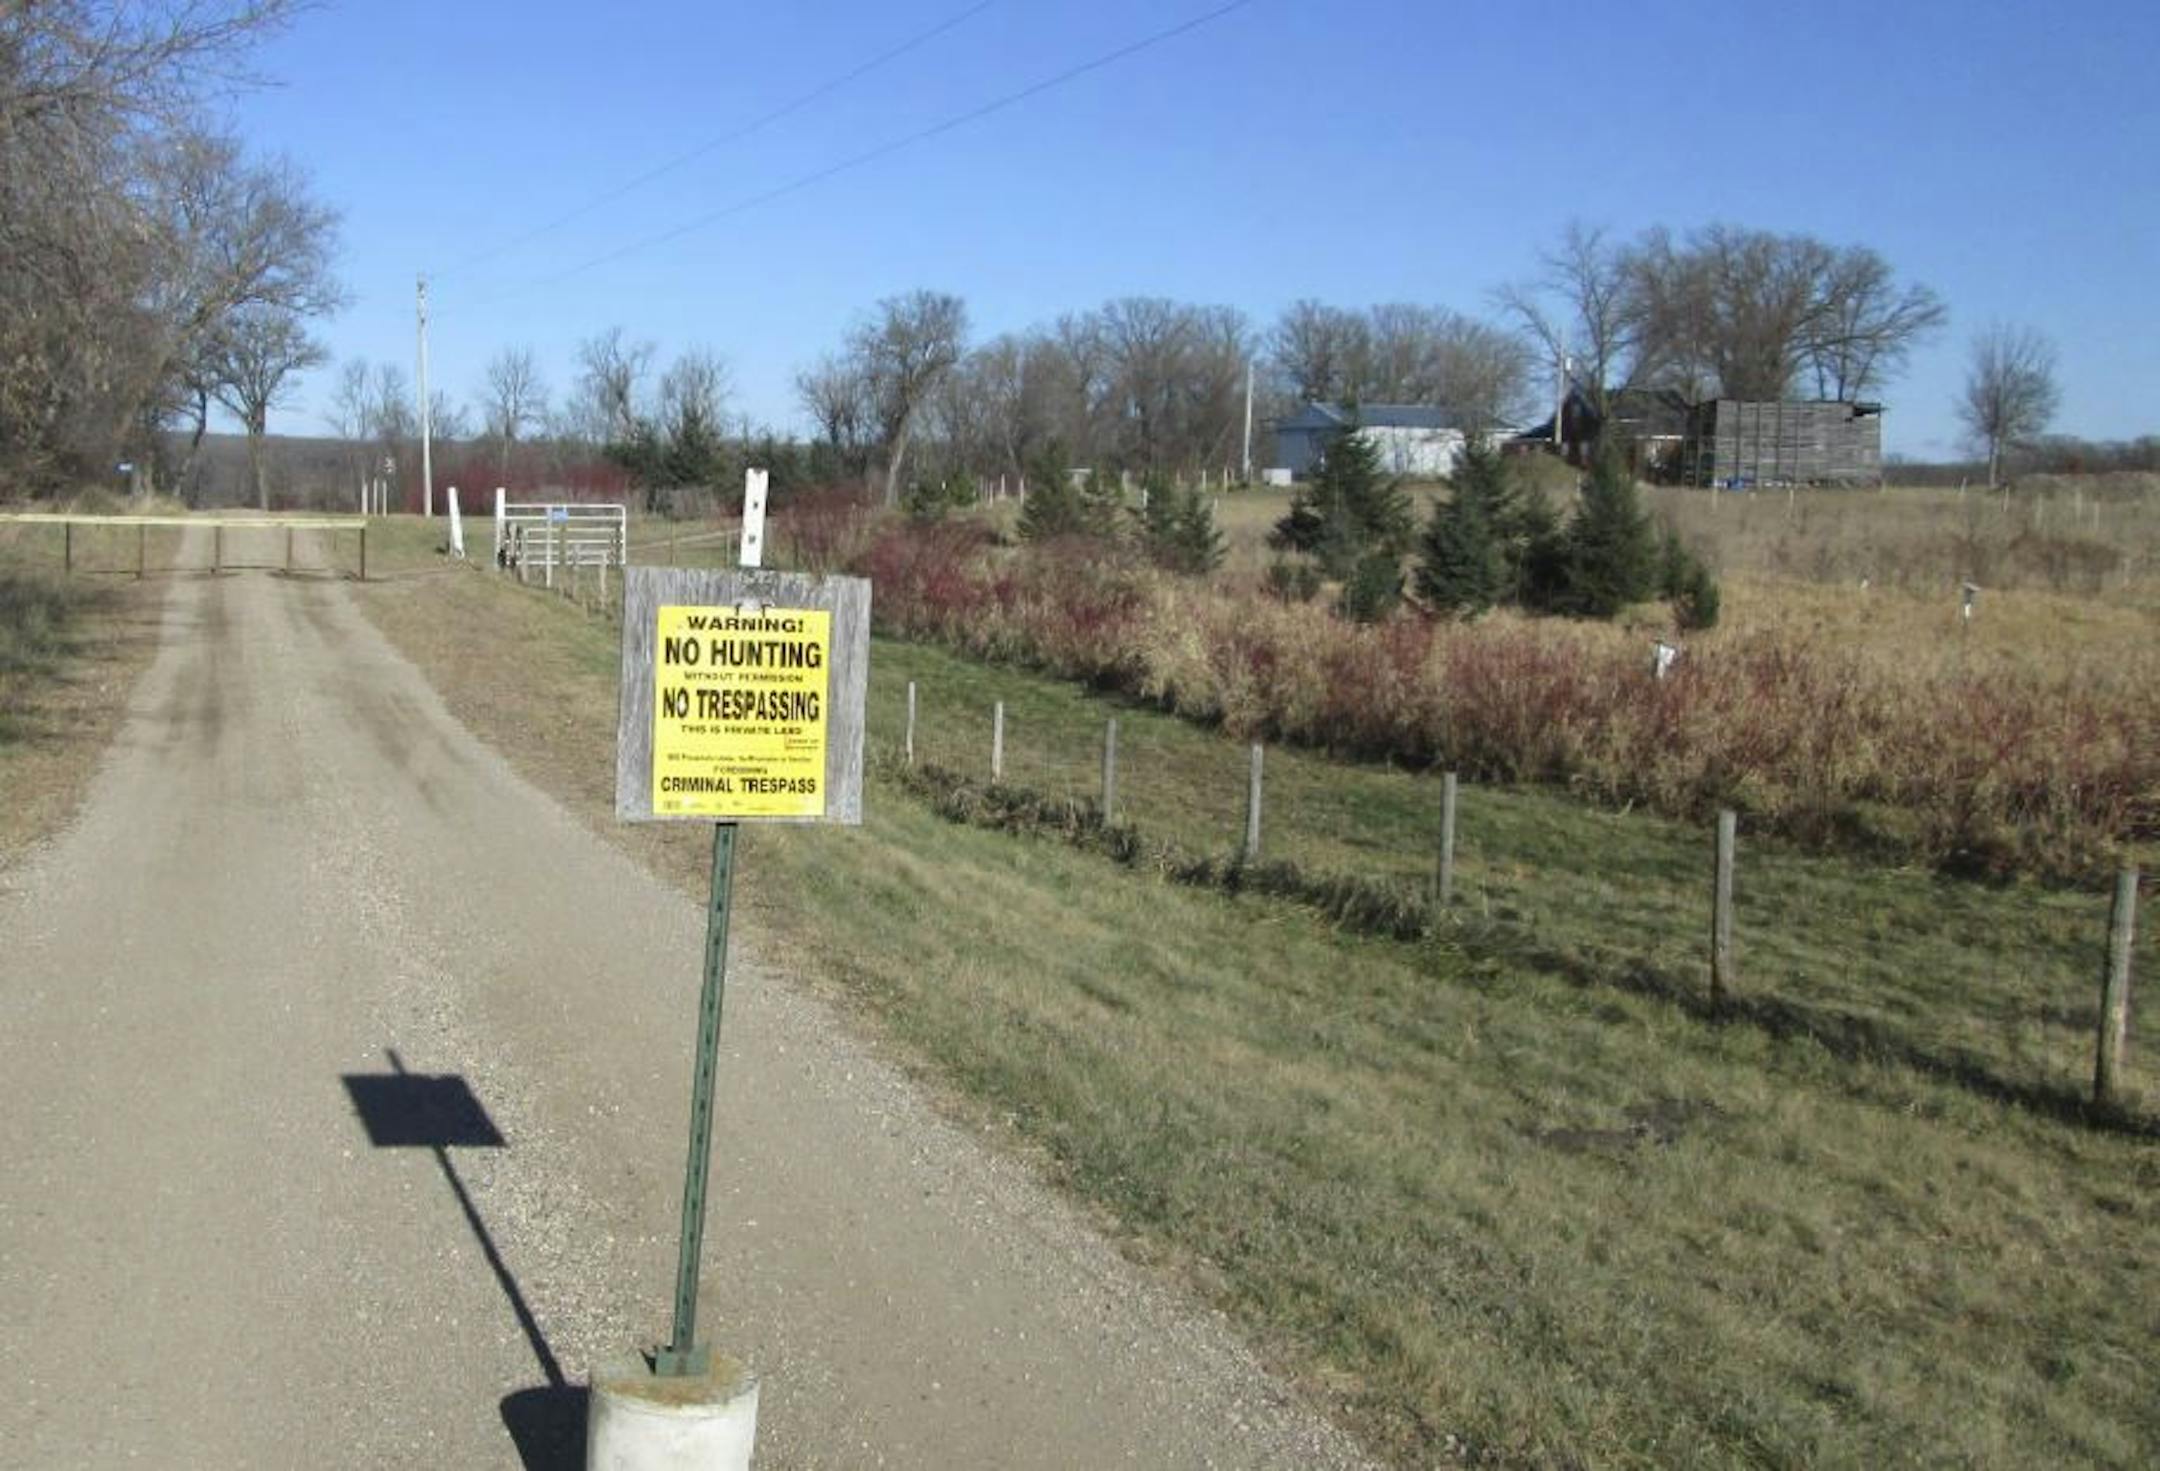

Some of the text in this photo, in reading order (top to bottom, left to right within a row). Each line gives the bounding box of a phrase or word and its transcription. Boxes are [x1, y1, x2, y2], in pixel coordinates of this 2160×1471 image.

[687, 616, 804, 633] WARNING!
[665, 637, 822, 668] NO HUNTING
[663, 687, 820, 721] NO TRESPASSING
[681, 724, 706, 734] THIS
[710, 725, 721, 734] IS
[661, 776, 816, 794] CRIMINAL TRESPASS
